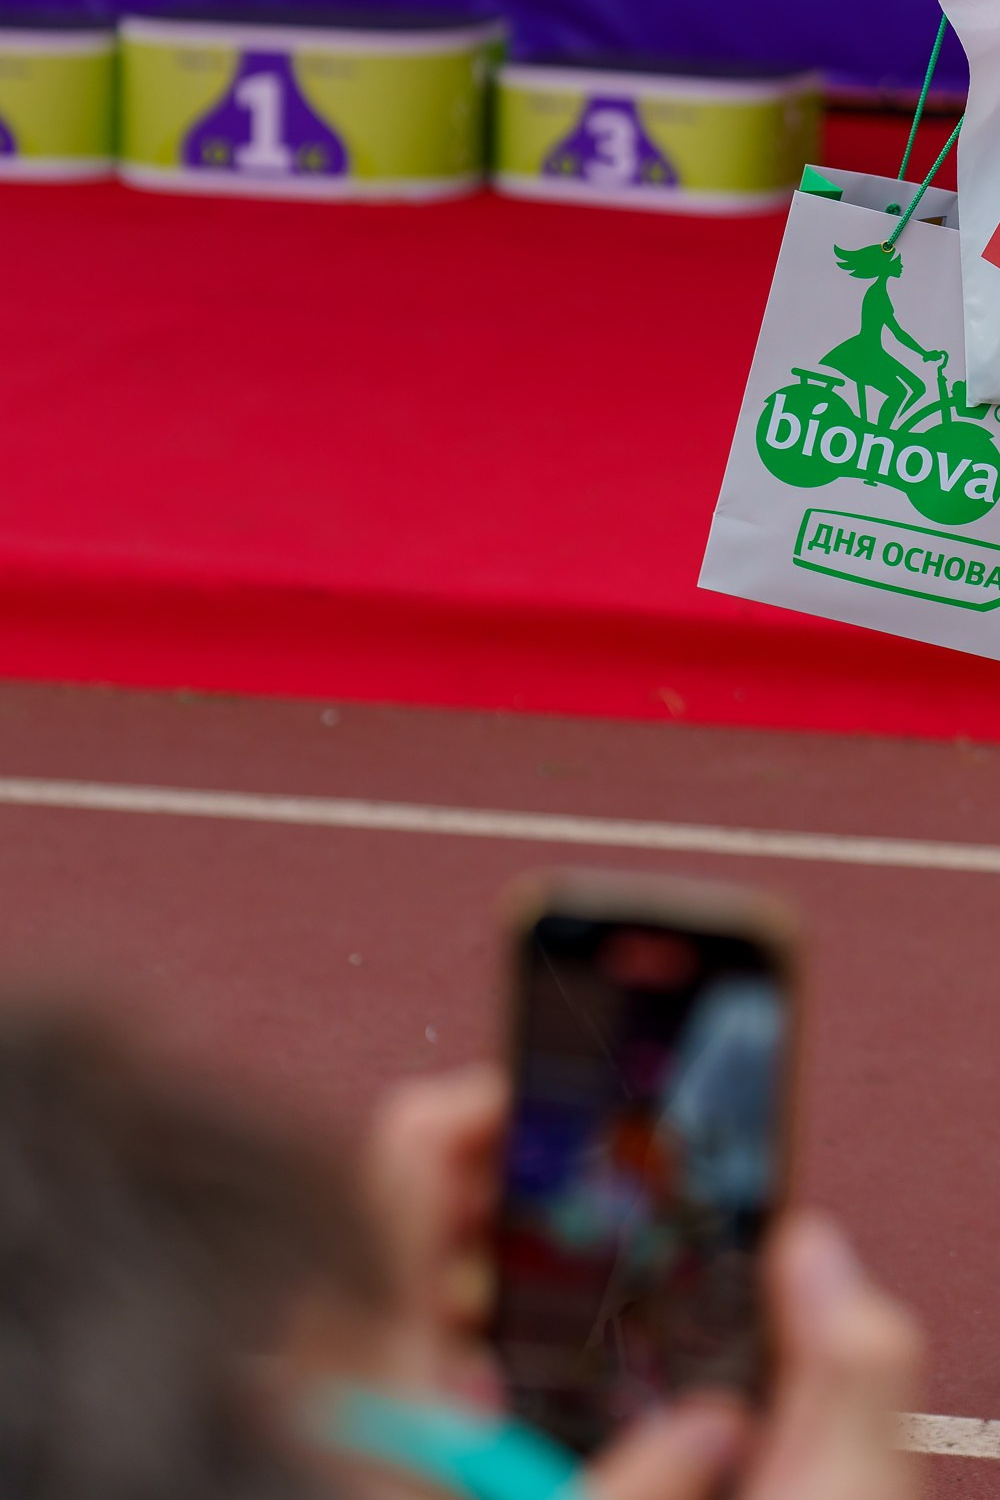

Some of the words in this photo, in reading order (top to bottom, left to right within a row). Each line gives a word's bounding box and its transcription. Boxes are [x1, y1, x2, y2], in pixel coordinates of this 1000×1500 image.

[236, 72, 293, 169] 1
[588, 108, 639, 187] 3
[765, 394, 999, 504] bionova
[808, 522, 876, 561] ДНЯ
